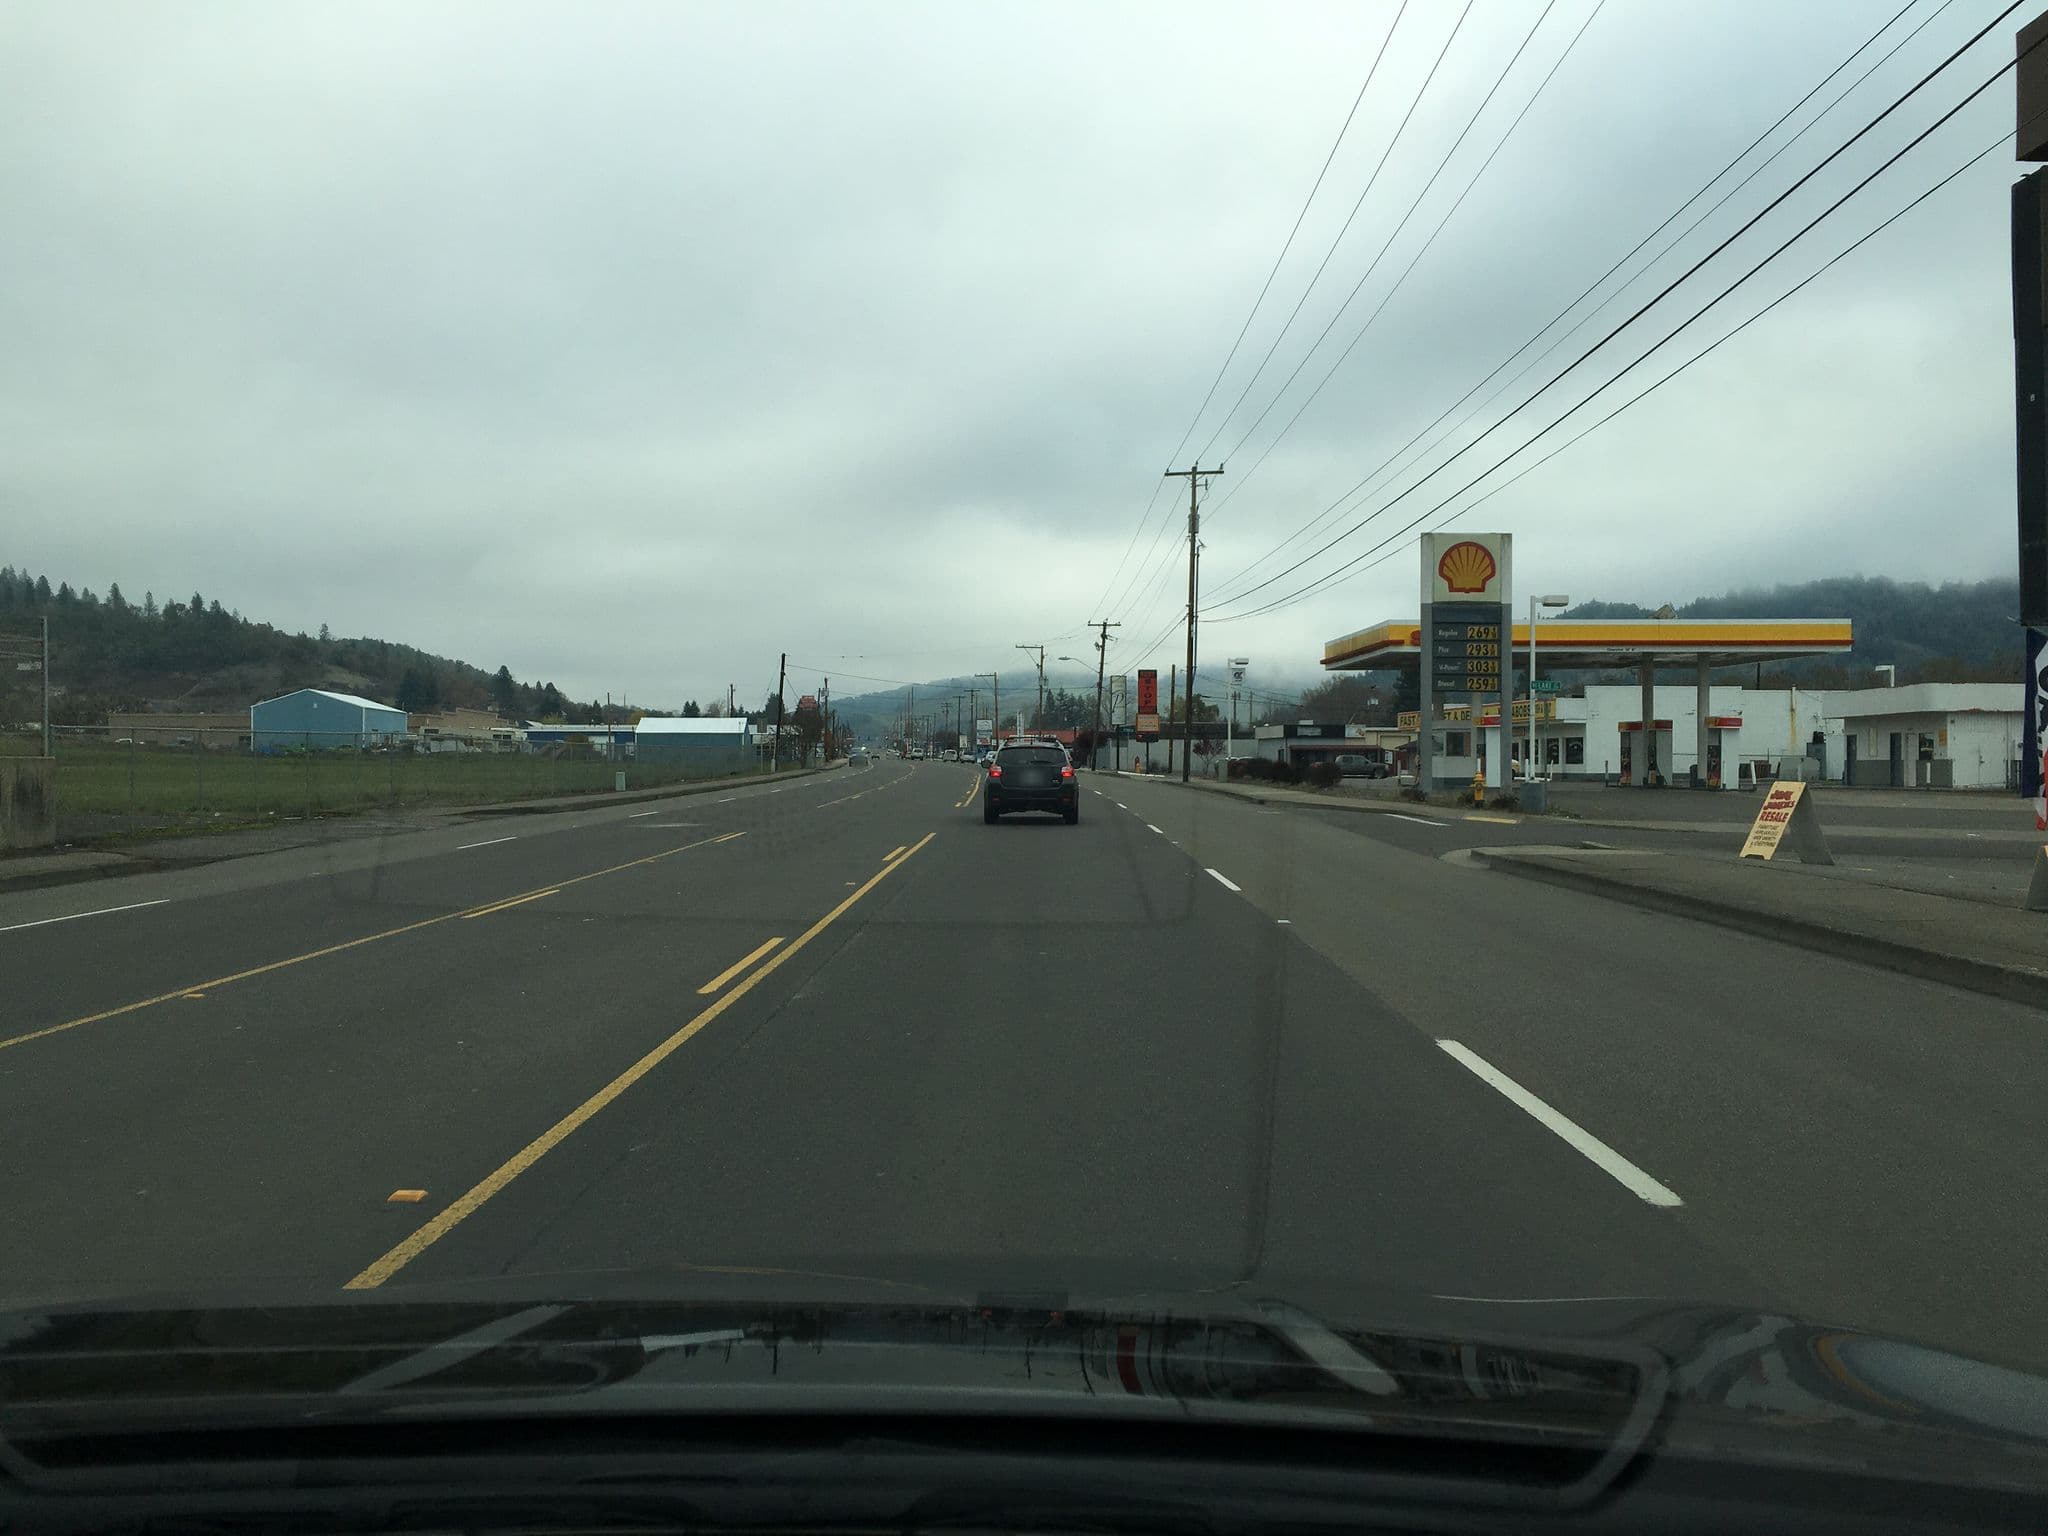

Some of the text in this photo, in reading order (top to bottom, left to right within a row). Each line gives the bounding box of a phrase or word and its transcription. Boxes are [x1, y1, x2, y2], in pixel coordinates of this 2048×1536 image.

[1468, 627, 1490, 639] 269
[1468, 644, 1489, 655] 293
[1468, 661, 1490, 673] 303
[1468, 678, 1490, 690] 259
[1400, 715, 1417, 726] FAST
[1759, 811, 1790, 823] RESALE
